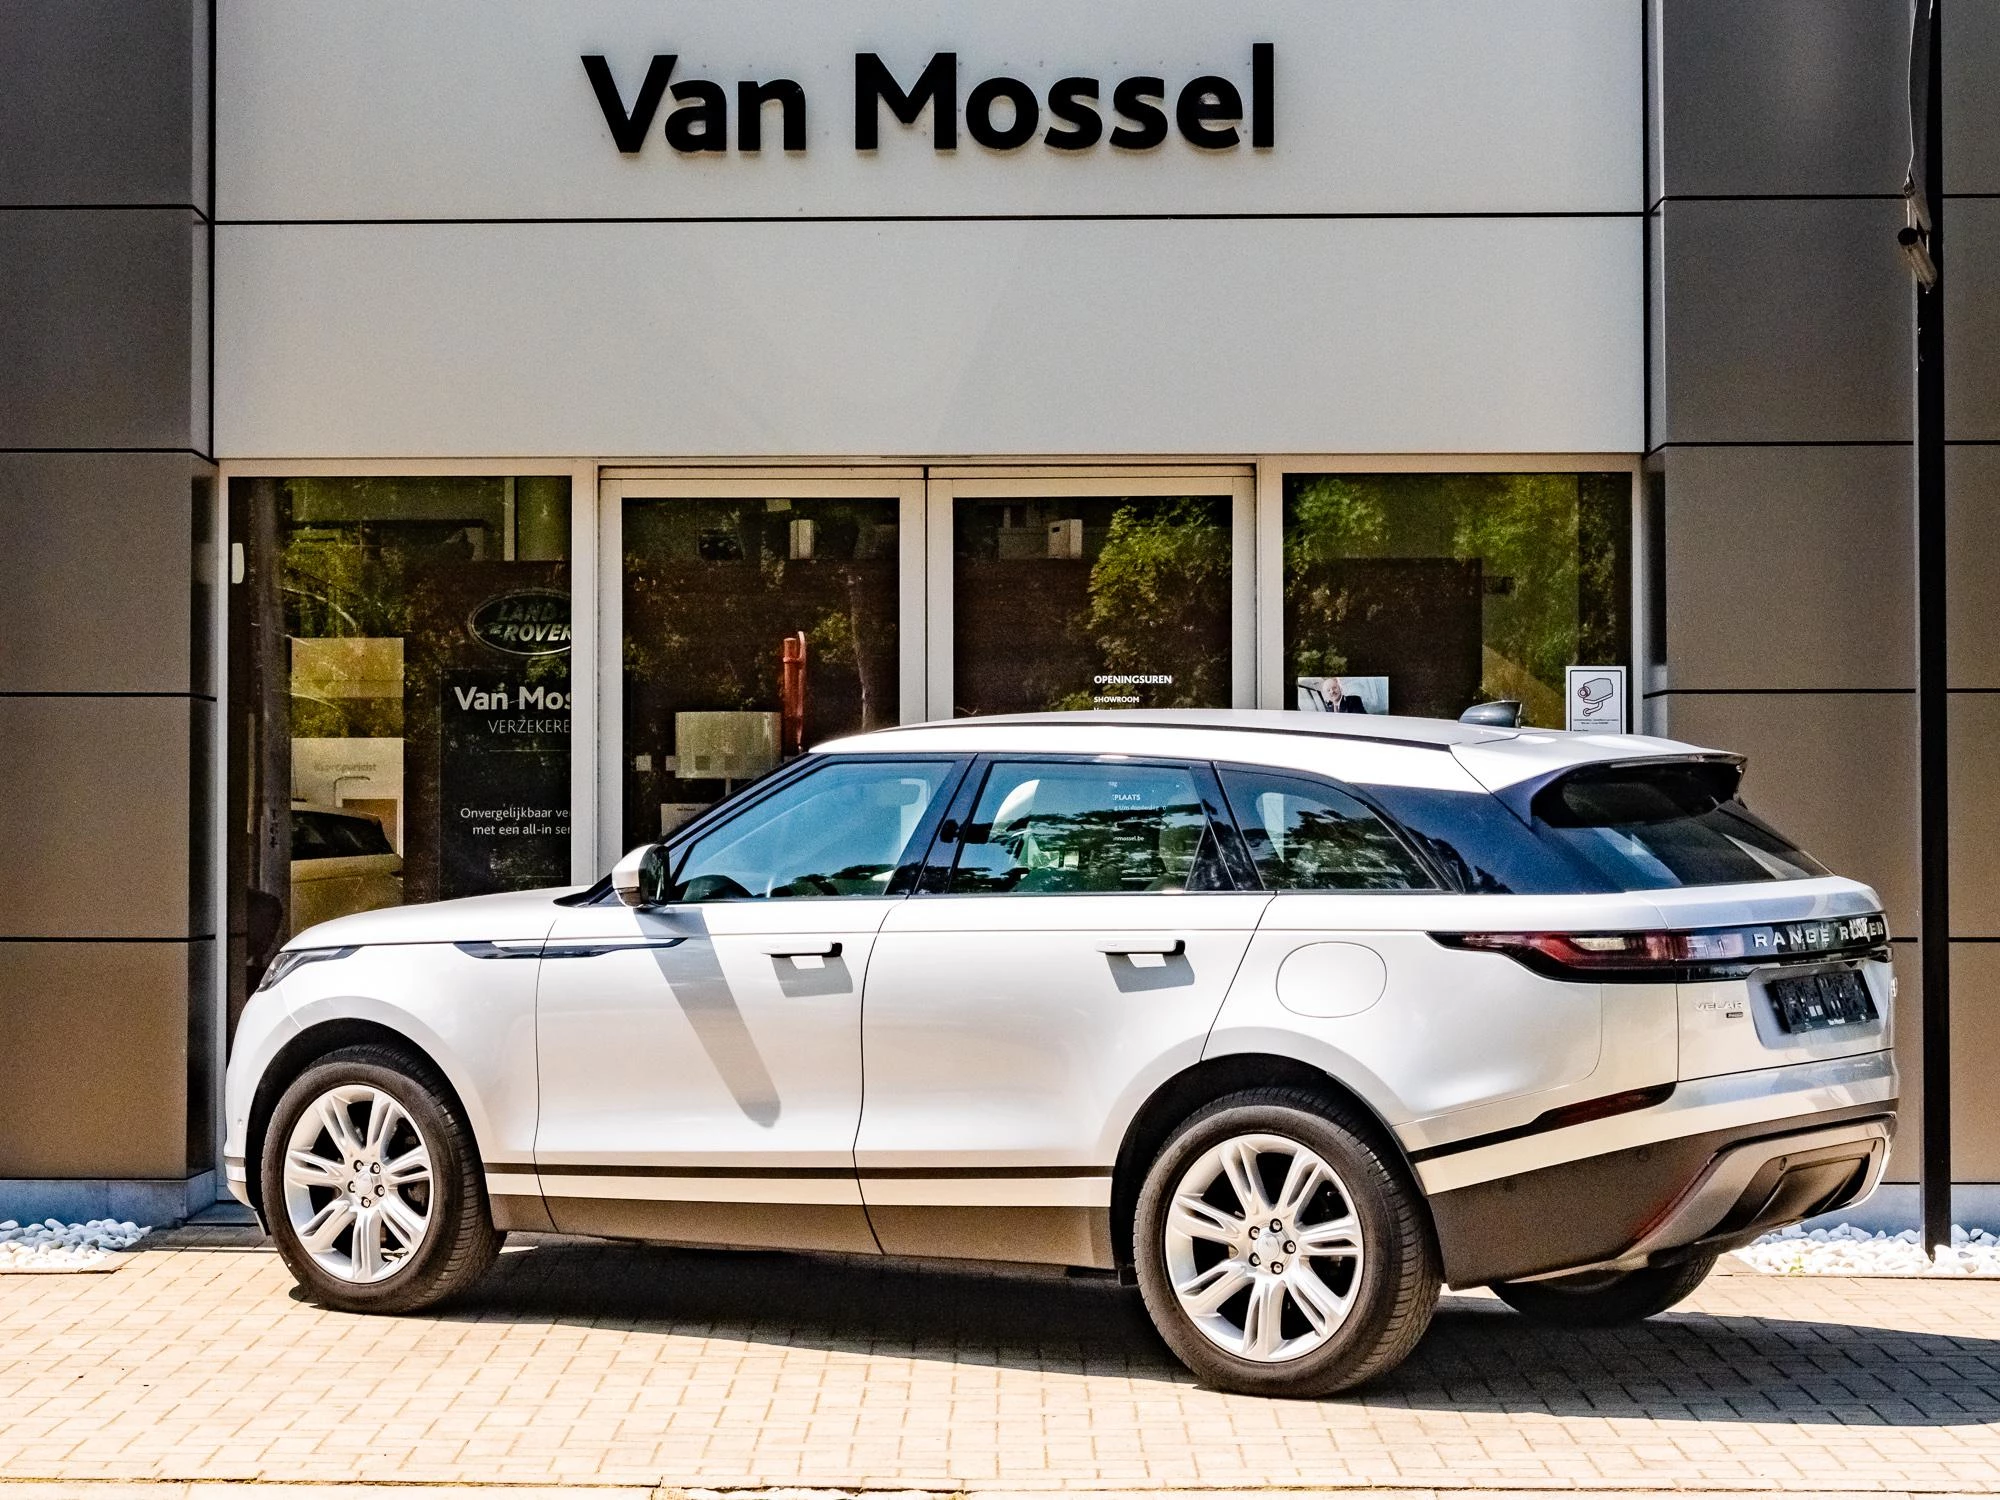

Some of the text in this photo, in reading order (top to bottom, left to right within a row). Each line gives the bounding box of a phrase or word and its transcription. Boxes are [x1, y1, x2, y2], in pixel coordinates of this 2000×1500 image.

[580, 42, 1275, 153] Van Mossel
[497, 602, 555, 622] LAND
[1093, 674, 1173, 685] OPENINGSUREN
[453, 685, 509, 711] Van
[1093, 695, 1140, 704] SHOWROOM
[487, 719, 571, 734] VERZEKERE
[1112, 793, 1141, 801] PLAATS
[460, 806, 571, 821] Onvergelijkbaar ve
[472, 825, 496, 835] met
[498, 826, 520, 835] een
[522, 824, 552, 835] all-in
[1753, 917, 1885, 948] RANGE ROVER
[1695, 1000, 1743, 1011] VELAR
